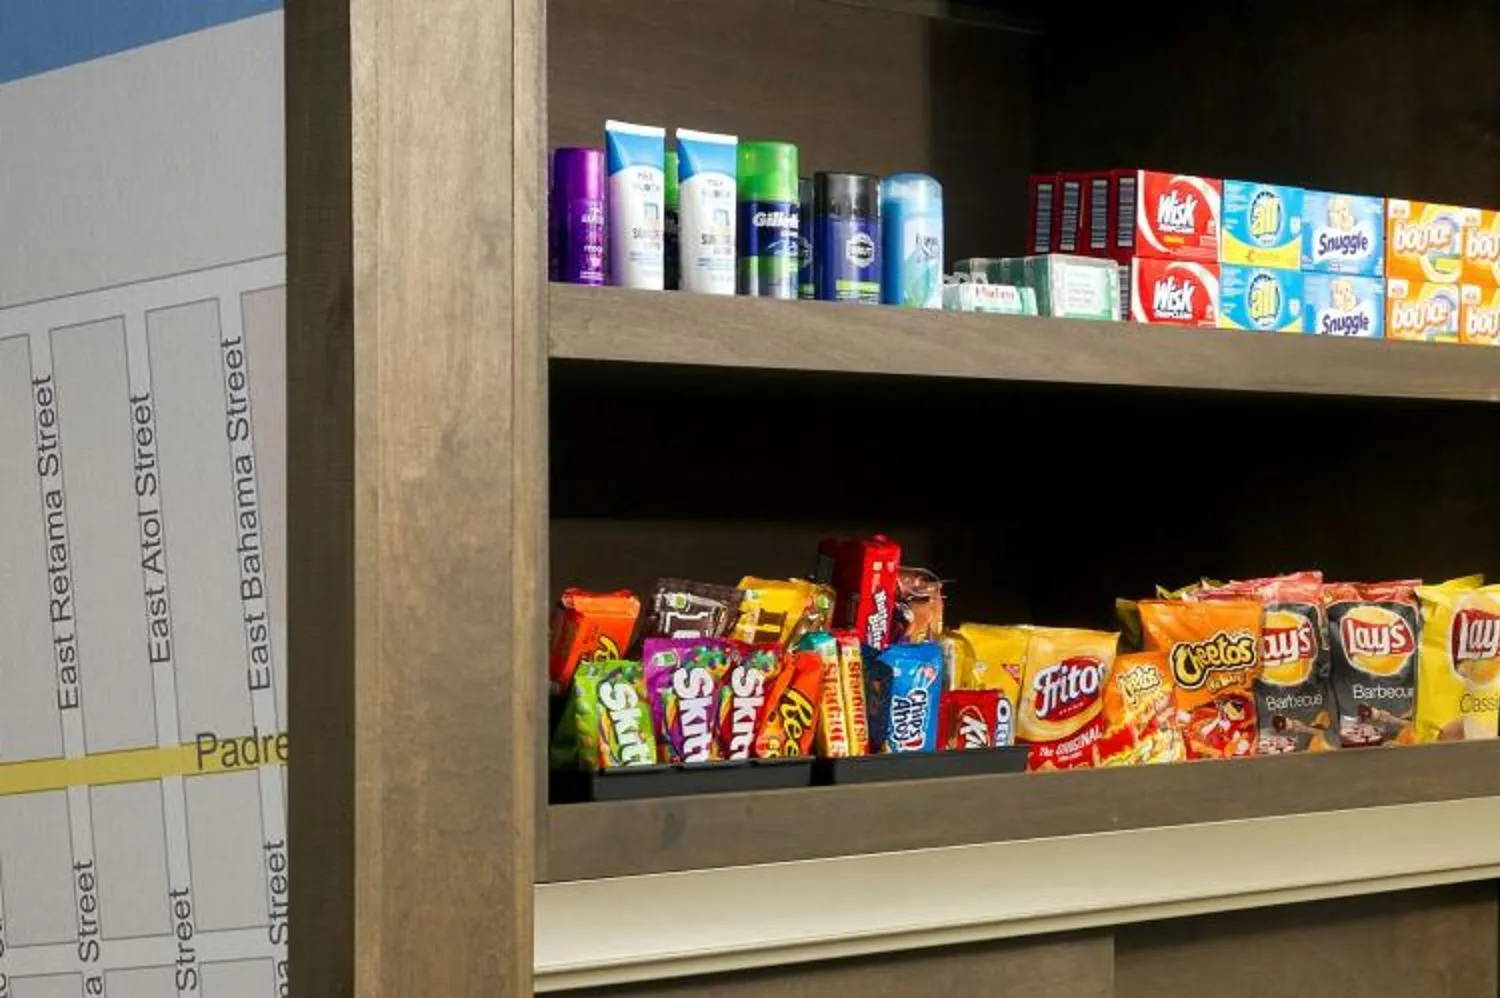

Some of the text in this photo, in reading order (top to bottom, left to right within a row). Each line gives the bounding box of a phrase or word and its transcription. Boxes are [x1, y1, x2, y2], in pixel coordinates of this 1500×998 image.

[1157, 190, 1198, 229] Wisk
[1252, 198, 1278, 237] all
[1318, 231, 1369, 257] Snuggle
[1153, 275, 1196, 314] Wisk
[1252, 281, 1277, 318] all
[1322, 312, 1369, 335] Snuggle
[130, 393, 171, 664] East Atol Street
[221, 336, 271, 691] East Bahama Street
[32, 374, 80, 710] East Retama Street
[1173, 634, 1255, 686] Cheetos
[908, 688, 927, 737] Chips
[196, 727, 288, 770] Padre
[73, 859, 100, 963] Street
[263, 840, 288, 945] Street
[169, 887, 197, 990] Street
